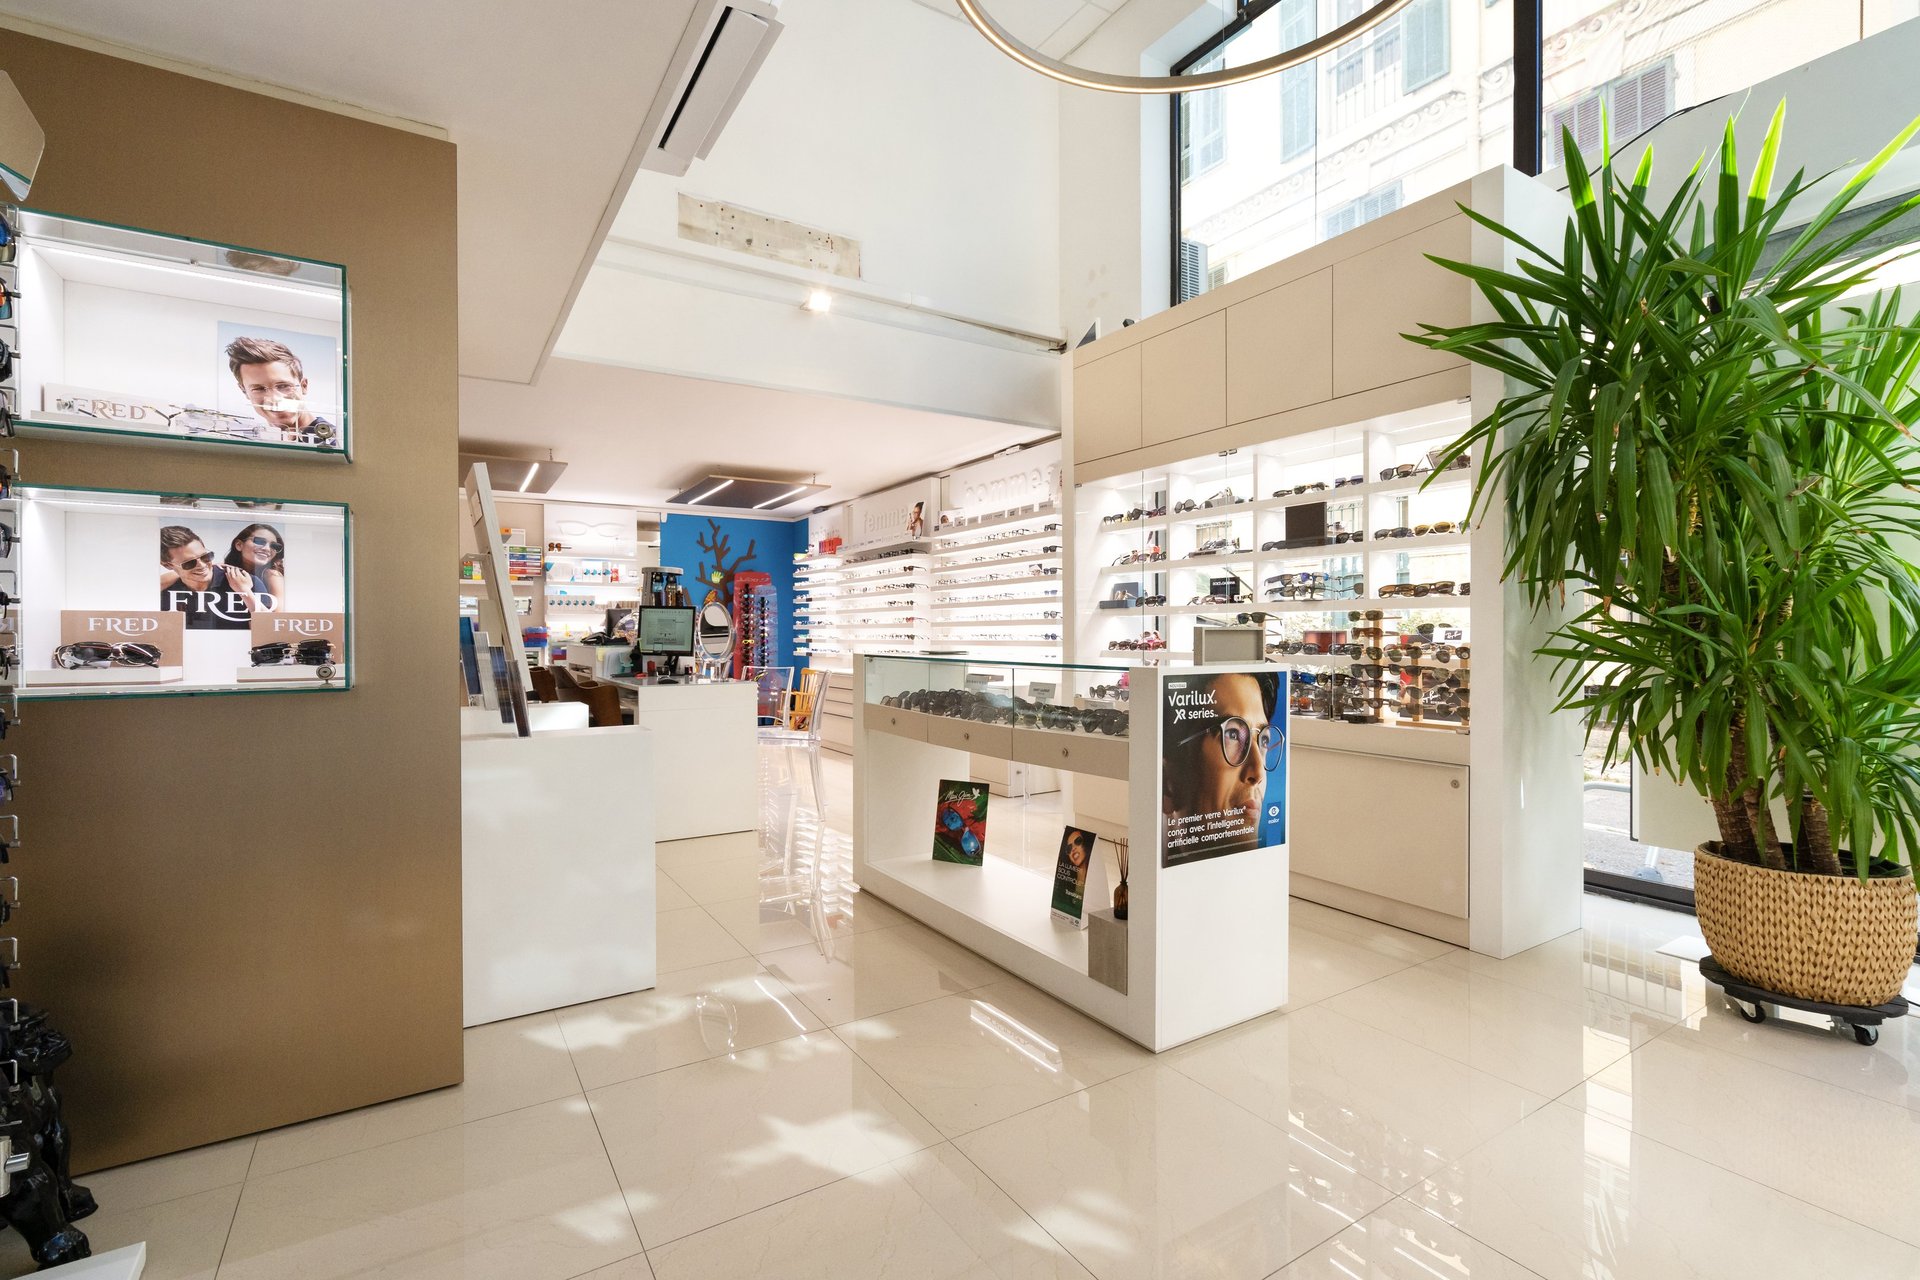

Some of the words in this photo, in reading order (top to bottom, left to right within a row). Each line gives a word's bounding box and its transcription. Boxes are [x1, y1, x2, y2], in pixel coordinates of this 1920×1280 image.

[168, 590, 278, 622] FRED
[88, 617, 158, 636] FRED
[274, 618, 334, 636] FRED
[1167, 818, 1176, 826] Le
[1178, 814, 1203, 826] premier
[1205, 812, 1222, 820] verre
[1167, 829, 1188, 838] conçu
[1190, 825, 1206, 833] avec
[1167, 836, 1200, 848] artificielle
[1201, 826, 1255, 842] comportementale
